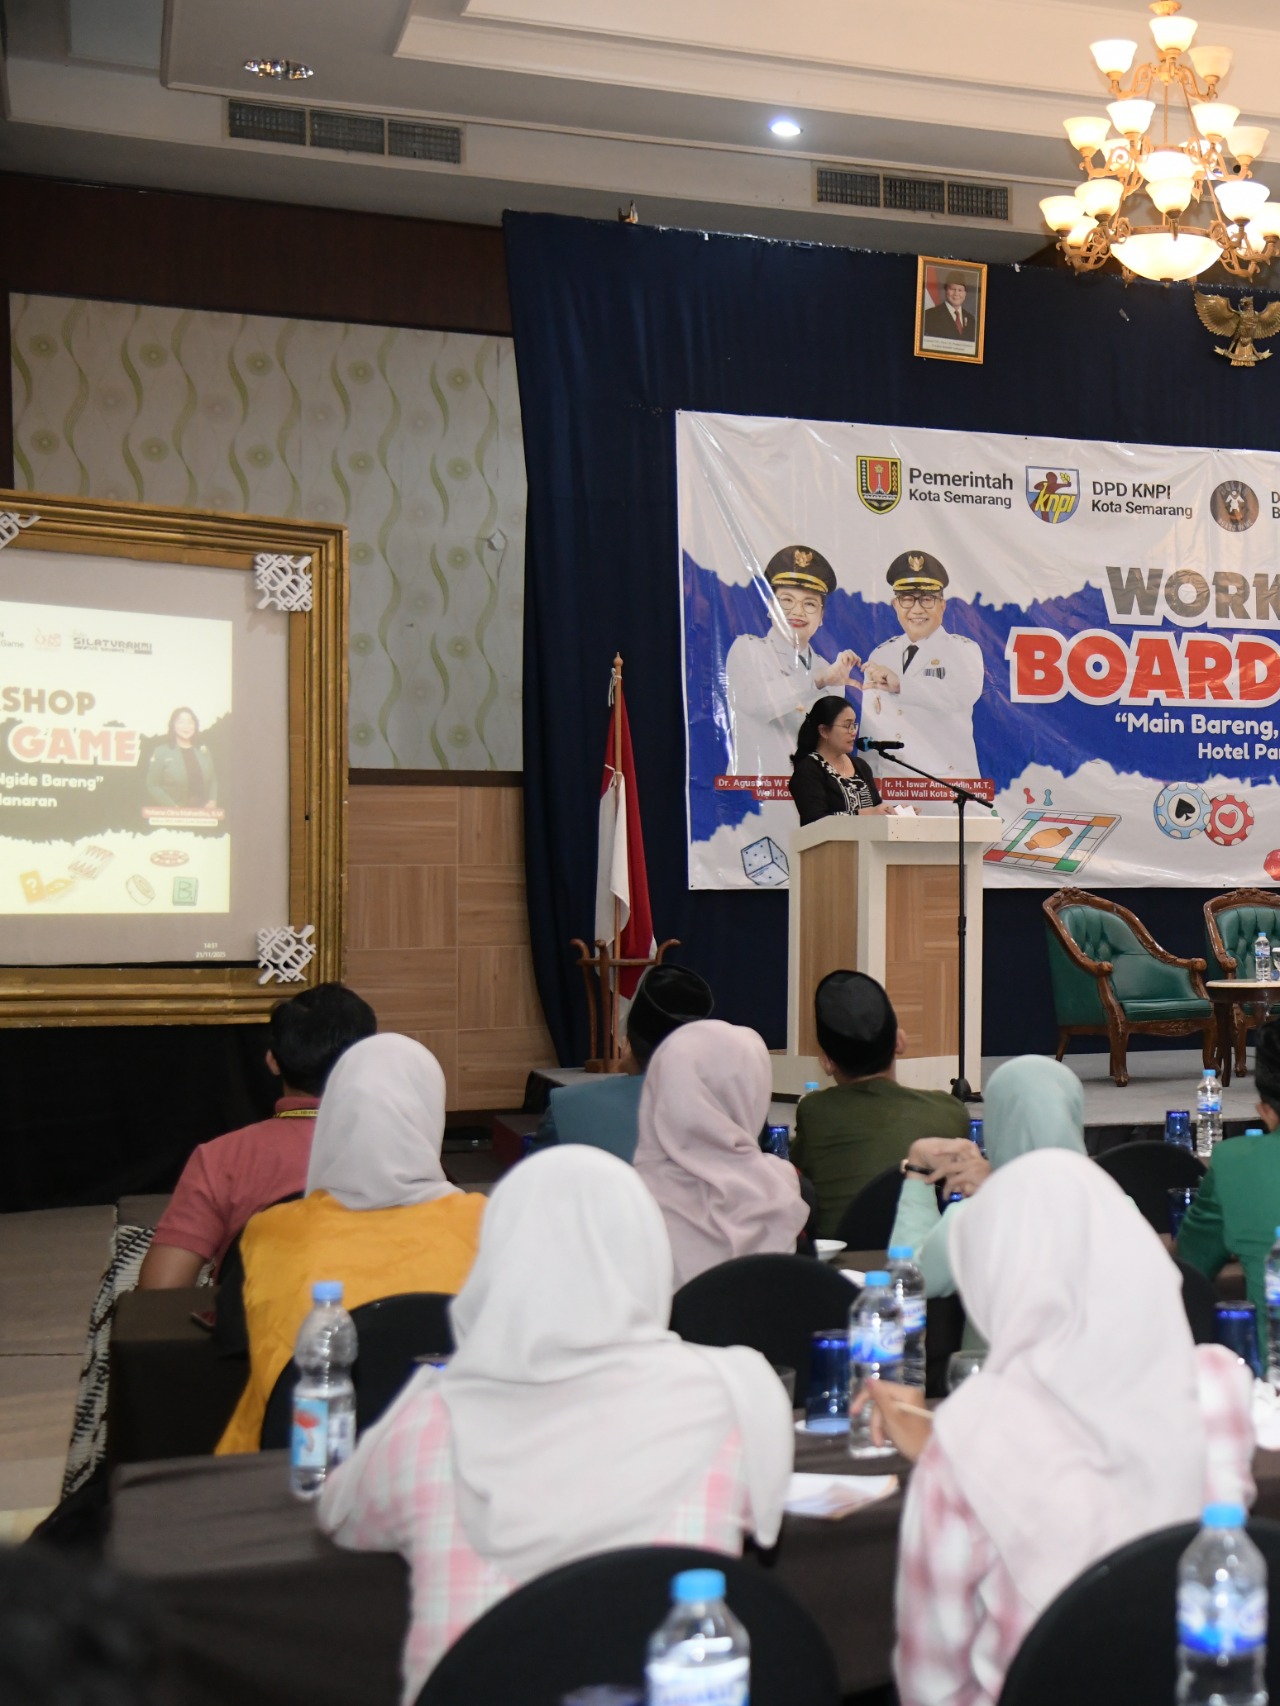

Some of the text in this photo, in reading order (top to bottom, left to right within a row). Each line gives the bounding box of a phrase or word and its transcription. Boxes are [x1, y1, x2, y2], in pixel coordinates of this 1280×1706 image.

[909, 467, 1013, 490] Pemerintah
[909, 488, 1012, 510] Kota Semarang
[1092, 481, 1171, 500] DPD KNPI
[1091, 499, 1193, 519] Kota Semarang
[0, 686, 95, 716] SHOP
[1192, 715, 1279, 740] Bareng,
[12, 726, 136, 763] GAME
[1198, 742, 1250, 761] Hotel
[718, 779, 731, 787] Dr.
[733, 779, 772, 788] Agusna
[896, 780, 904, 788] H.
[906, 780, 927, 788] Iswar
[930, 780, 972, 790] Amiuddin,
[887, 790, 987, 800] Wakil Wali Kota Seang
